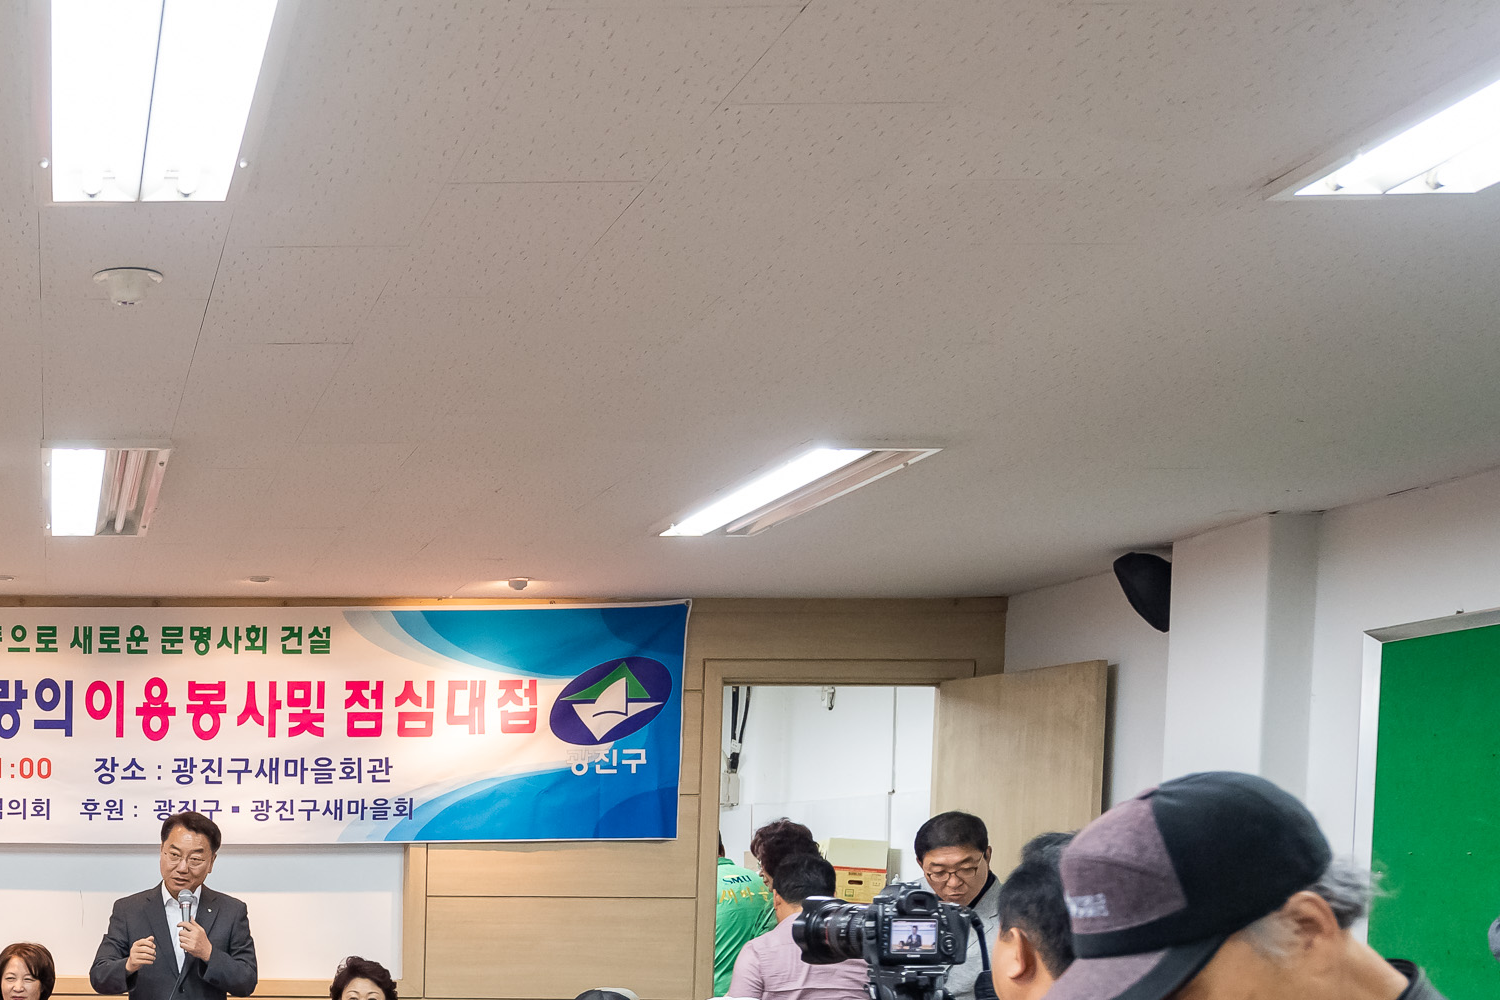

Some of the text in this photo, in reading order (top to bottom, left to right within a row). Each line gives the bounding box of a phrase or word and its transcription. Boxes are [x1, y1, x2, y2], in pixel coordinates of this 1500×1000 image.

[70, 625, 149, 655] 새로운
[161, 625, 268, 656] 문명사회
[281, 626, 331, 655] 건설
[344, 679, 538, 738] 점심대접
[171, 757, 393, 785] 광진구새마을회관
[566, 749, 647, 776] 광진구
[251, 797, 414, 821] 광진구새마을회
